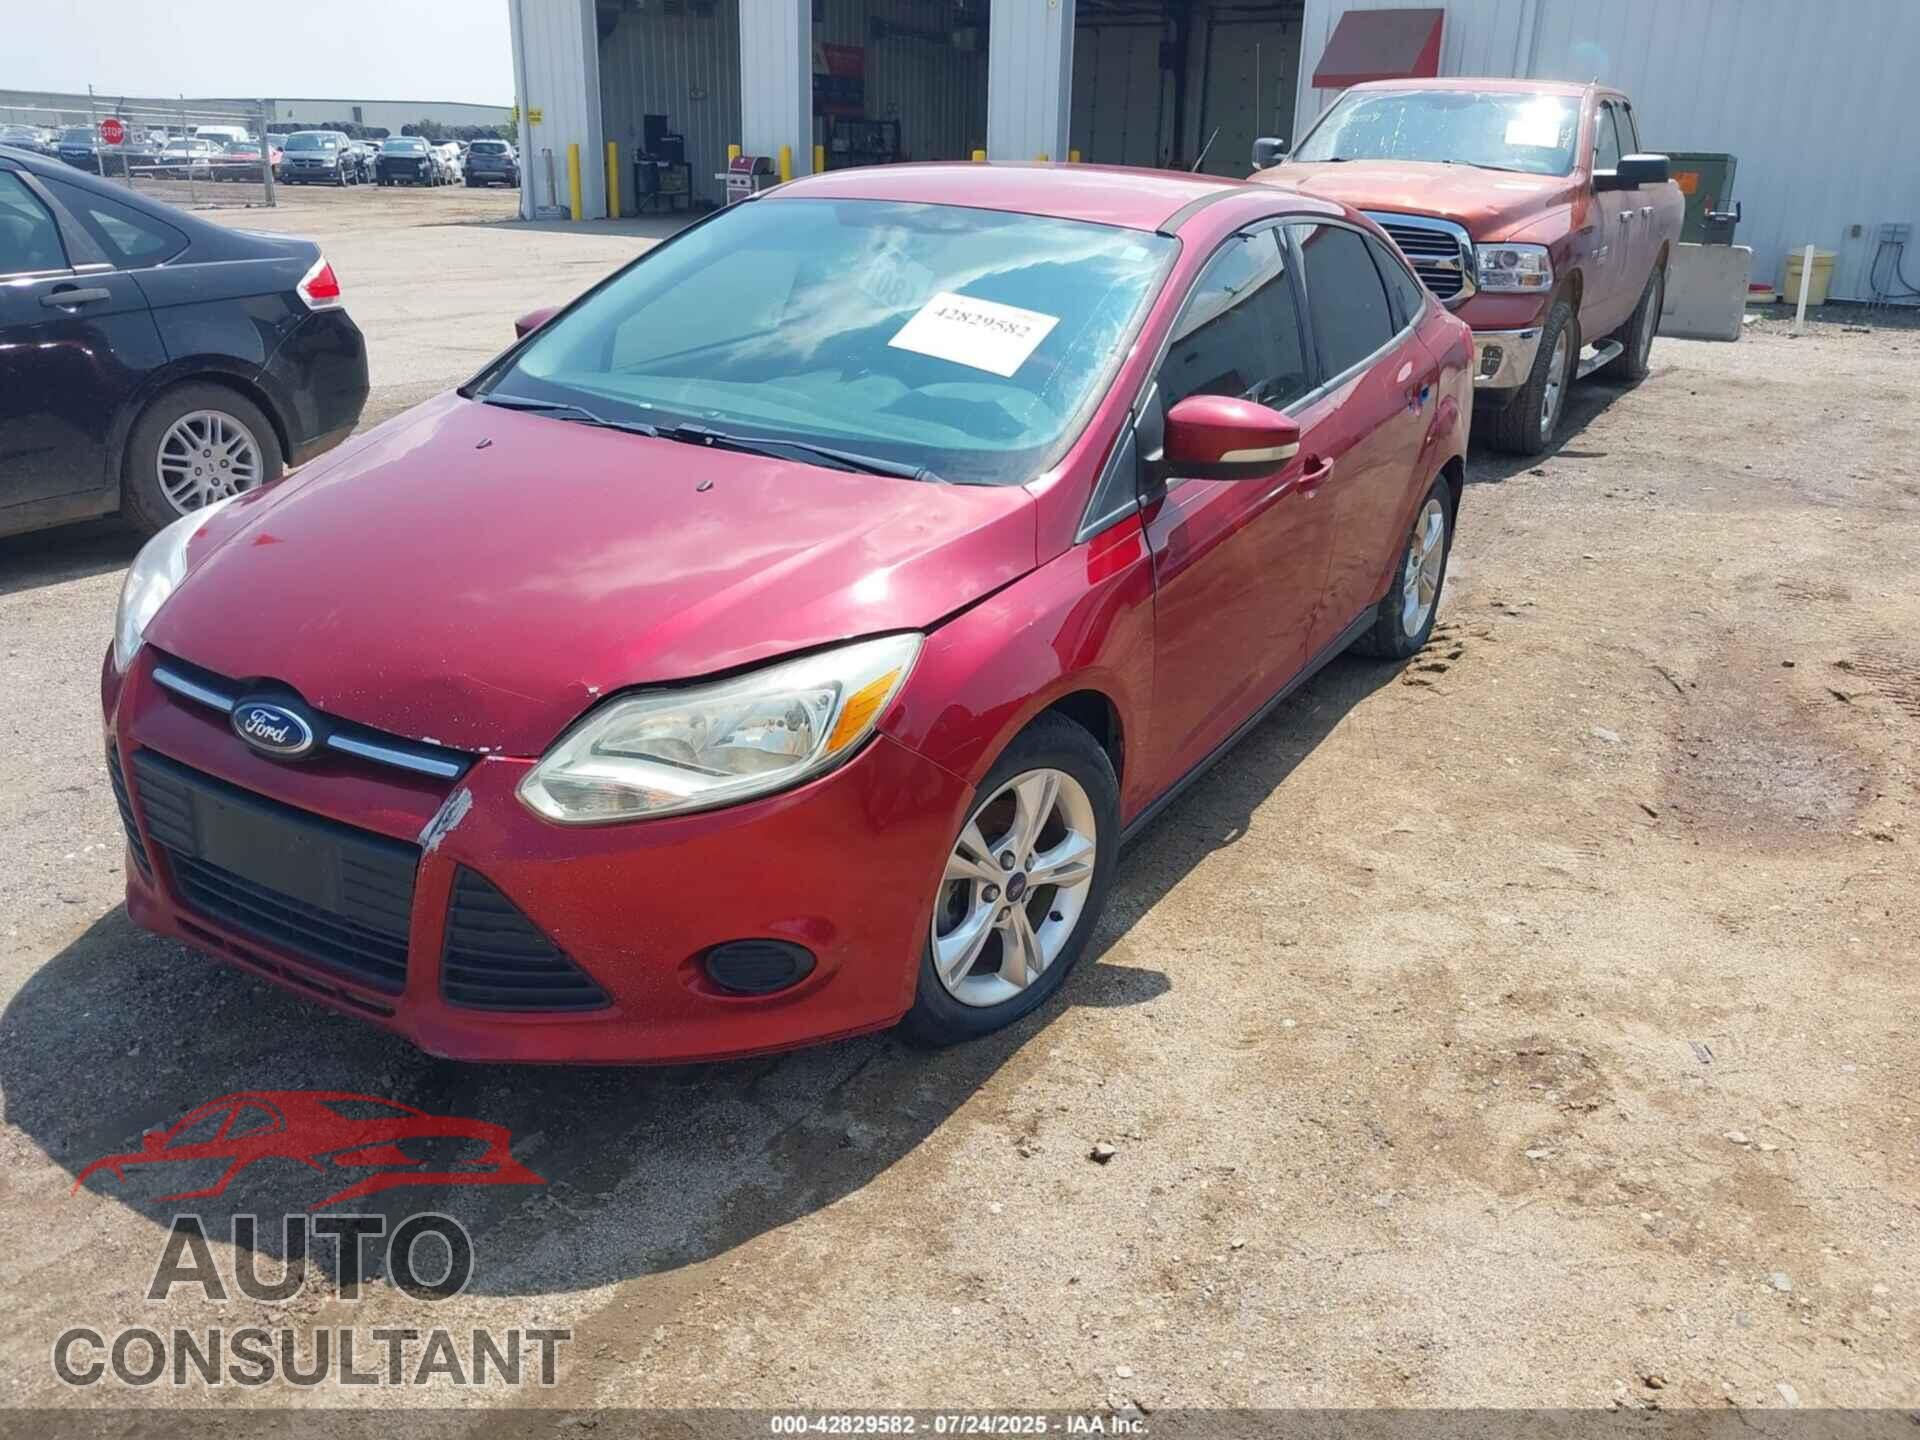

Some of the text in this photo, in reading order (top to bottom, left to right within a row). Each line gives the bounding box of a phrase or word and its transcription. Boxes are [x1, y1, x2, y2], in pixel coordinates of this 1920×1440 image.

[102, 126, 122, 137] STOP
[934, 307, 1031, 337] 42829582
[245, 709, 289, 743] Ford
